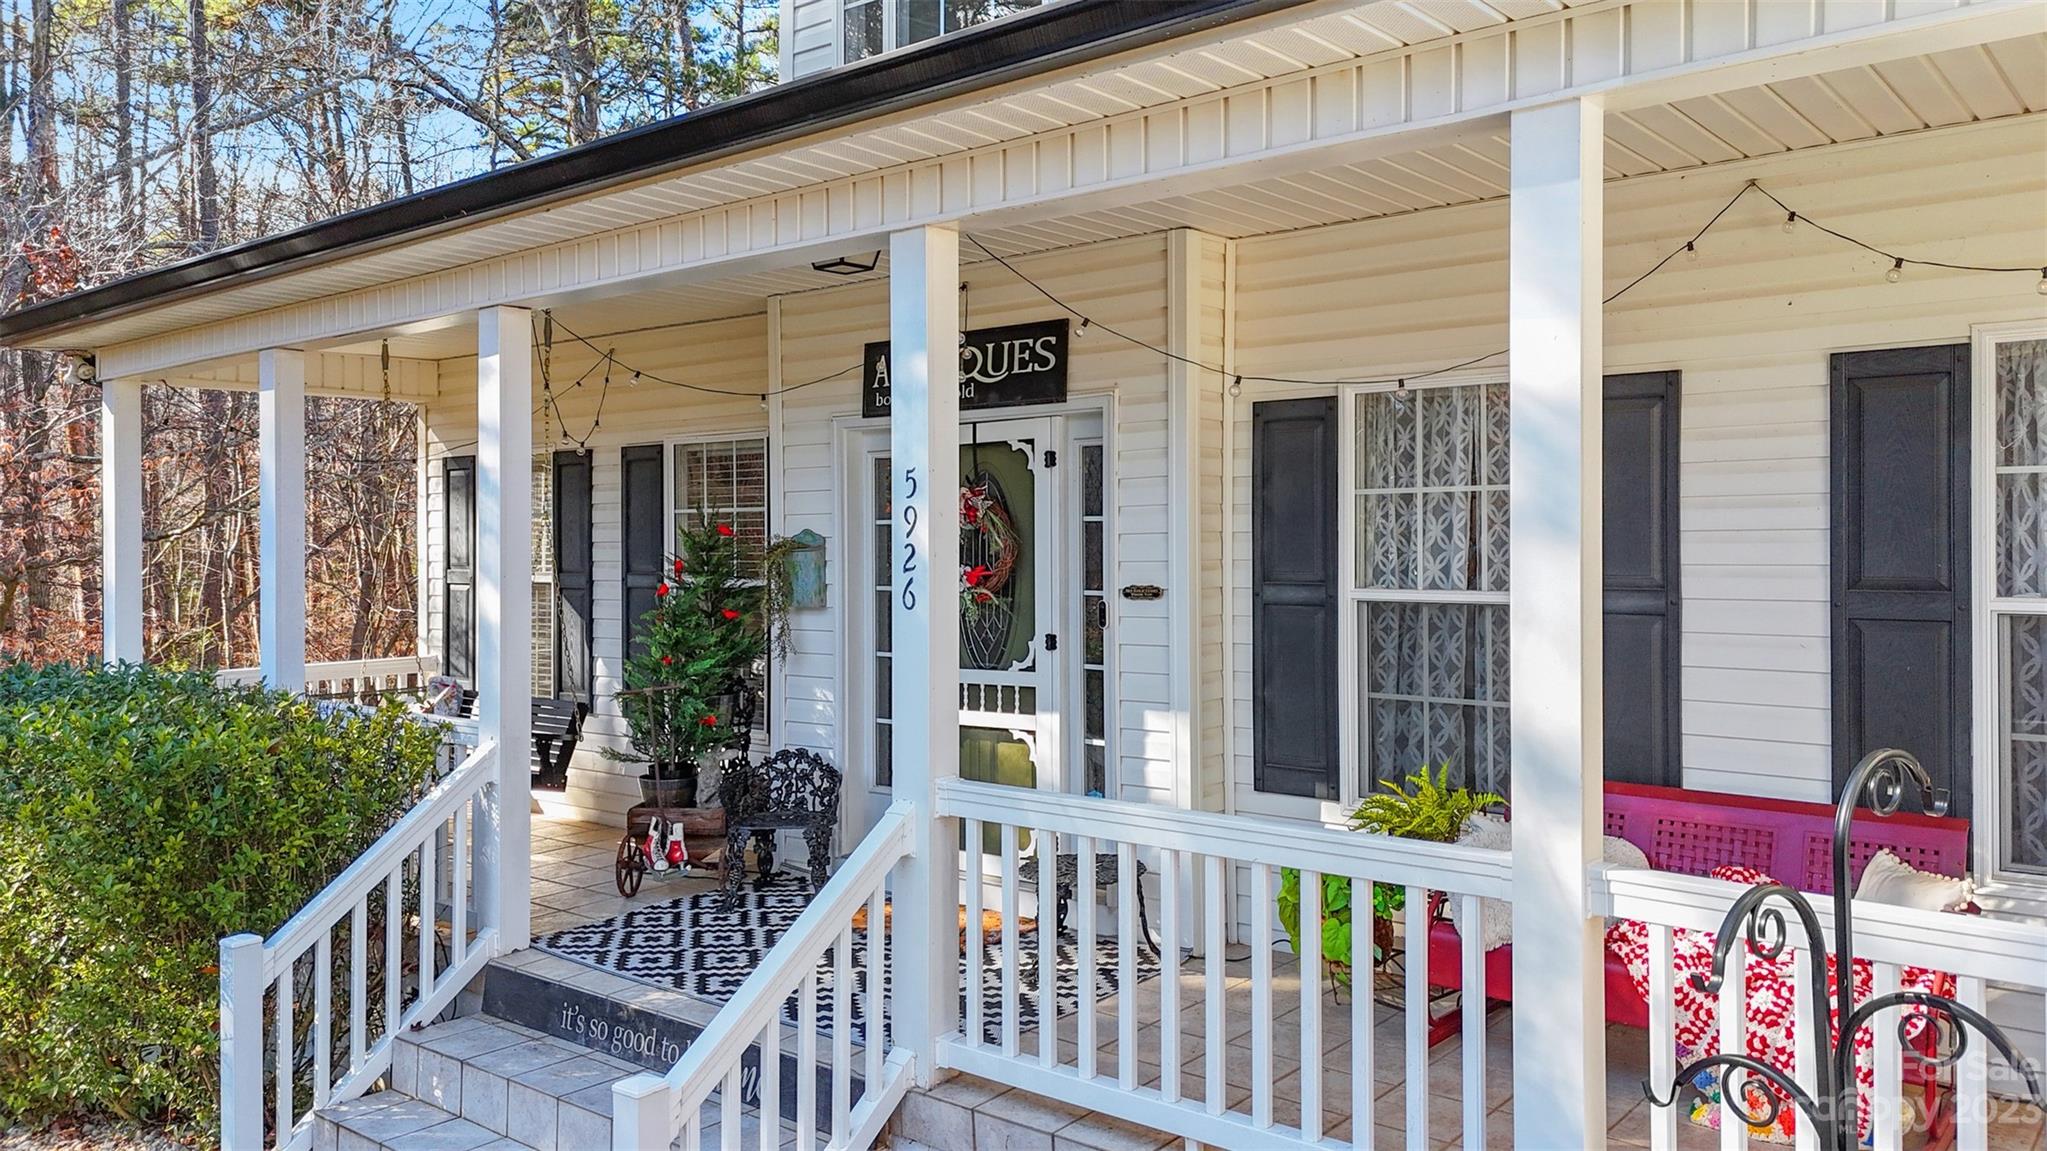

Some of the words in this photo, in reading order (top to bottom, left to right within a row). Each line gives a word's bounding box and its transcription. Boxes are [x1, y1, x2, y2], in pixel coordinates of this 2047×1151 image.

[873, 336, 1056, 389] AQUES
[902, 467, 918, 610] 5926
[561, 1002, 585, 1034] it's
[589, 1018, 608, 1041] so
[611, 1025, 657, 1057] good
[661, 1036, 680, 1065] to
